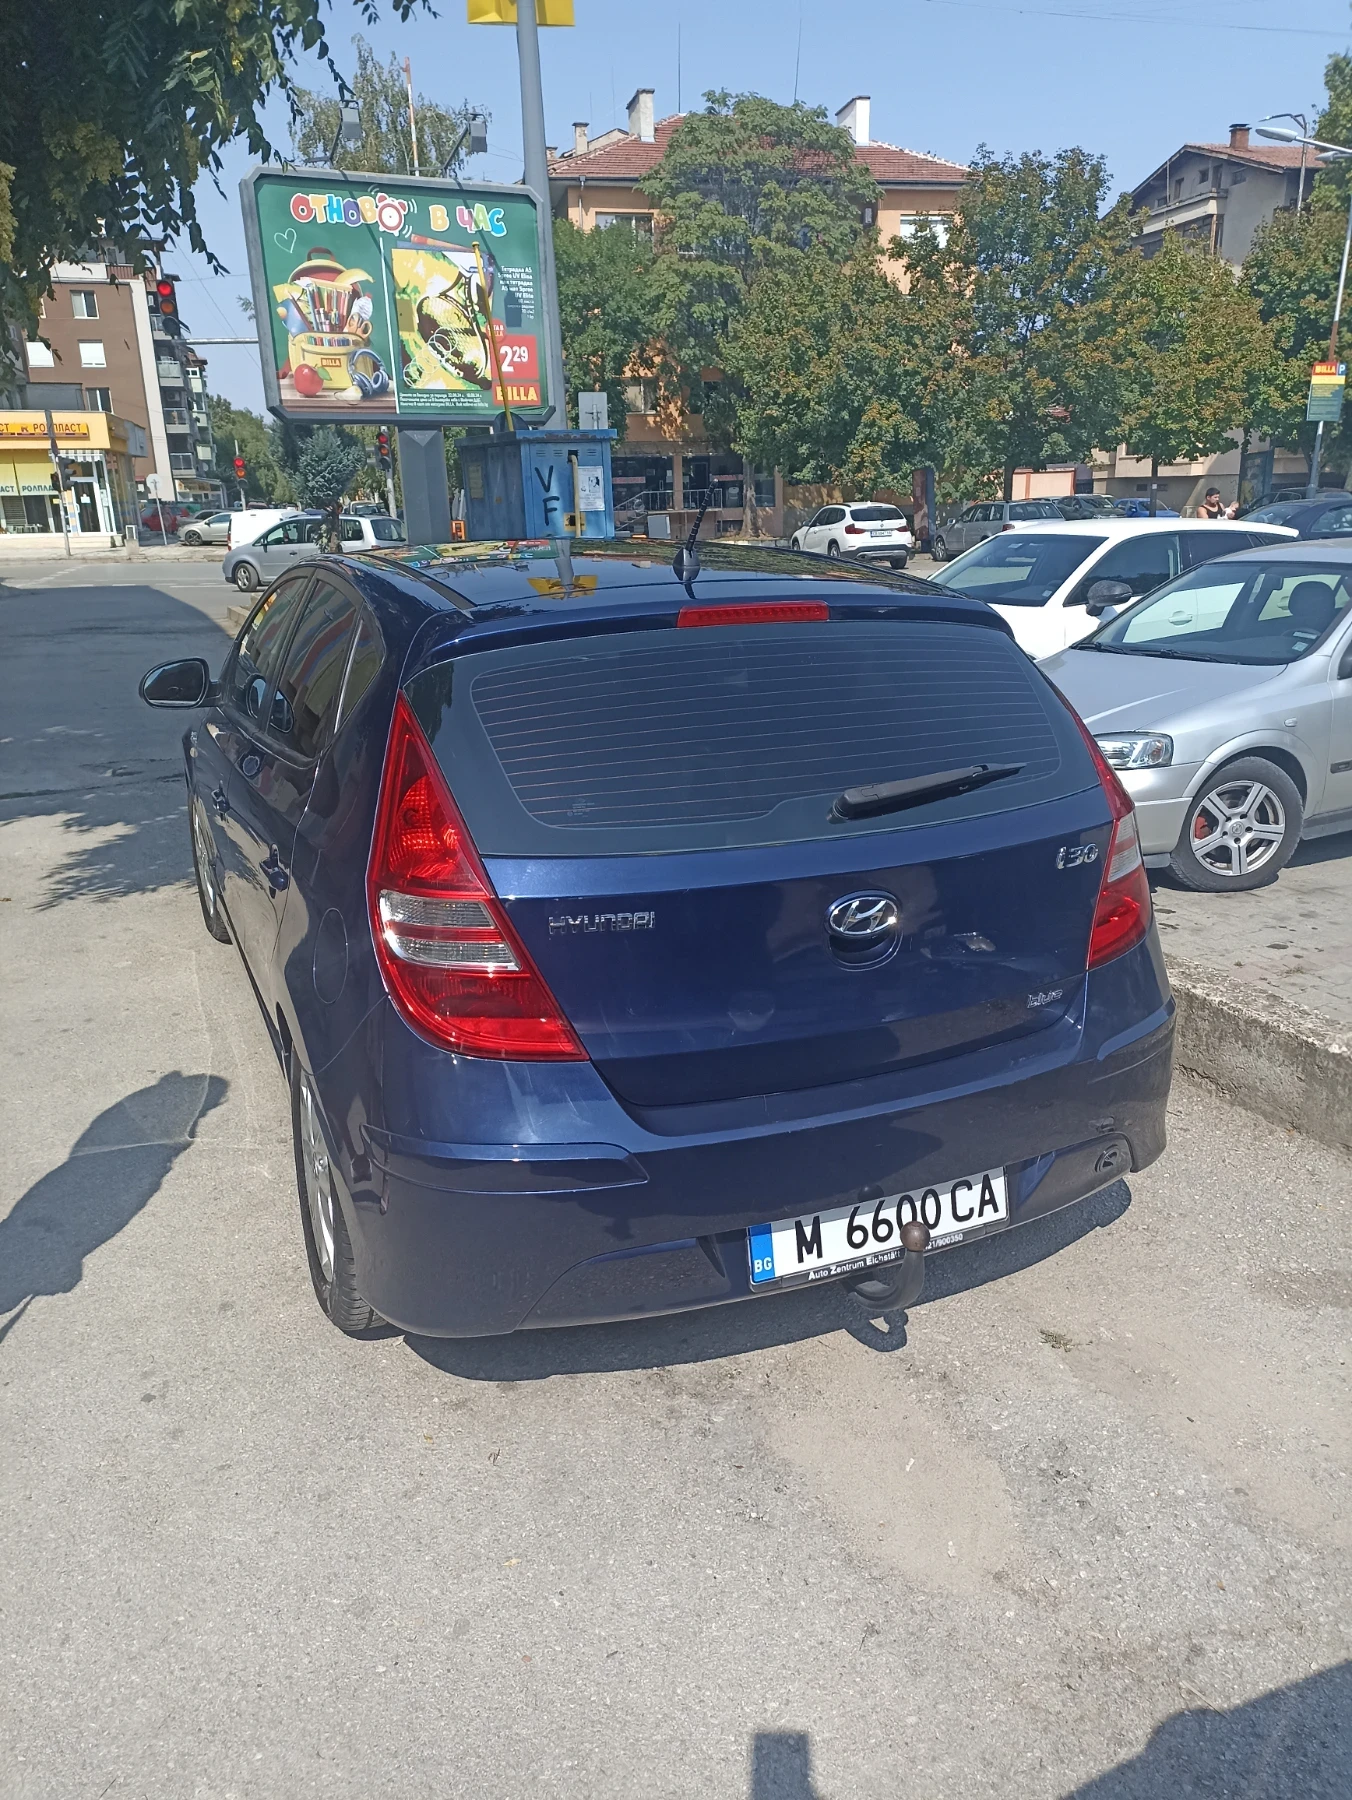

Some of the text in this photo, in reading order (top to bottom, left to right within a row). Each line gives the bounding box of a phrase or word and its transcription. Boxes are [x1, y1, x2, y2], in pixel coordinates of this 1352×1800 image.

[429, 204, 449, 232] В
[456, 203, 507, 237] ЧАС
[321, 358, 341, 367] BILLA
[1315, 365, 1336, 374] BILLA
[33, 423, 81, 433] РОПЛАСТ
[549, 911, 655, 935] HYUNDAI
[794, 1174, 999, 1264] M 6600 CA
[753, 1256, 773, 1273] BG
[808, 1270, 829, 1281] Auto
[830, 1260, 865, 1275] Zentrum
